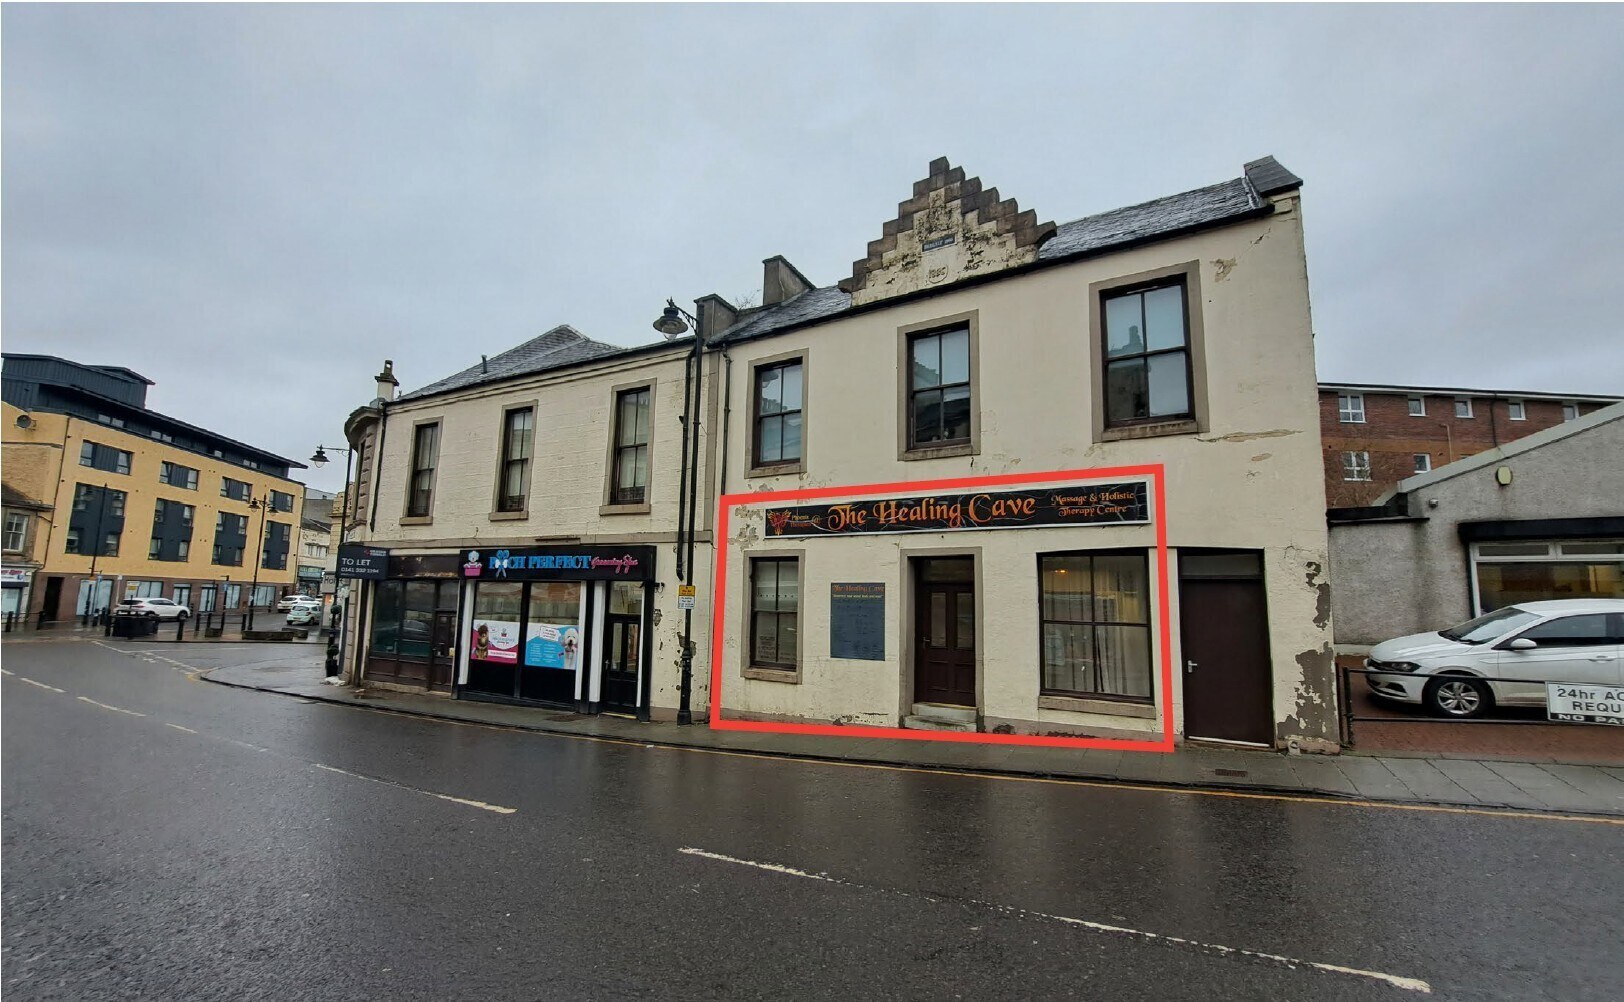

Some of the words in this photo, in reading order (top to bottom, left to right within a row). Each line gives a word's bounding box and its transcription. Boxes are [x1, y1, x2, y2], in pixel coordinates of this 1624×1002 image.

[1051, 494, 1087, 506] Massage
[1089, 493, 1098, 502] &
[1098, 491, 1135, 502] Holistic
[827, 504, 867, 531] The
[872, 498, 962, 528] Healing
[968, 494, 1036, 523] Cave
[1058, 506, 1096, 517] Therapy
[1096, 506, 1128, 515] Centre
[341, 557, 355, 566] TO
[356, 558, 371, 566] LET
[488, 555, 527, 569] PCH
[527, 555, 592, 569] PERFECT
[1557, 688, 1595, 699] 24hr
[1572, 701, 1621, 713] REQU
[1558, 713, 1585, 721] NO
[1594, 716, 1624, 725] PA
